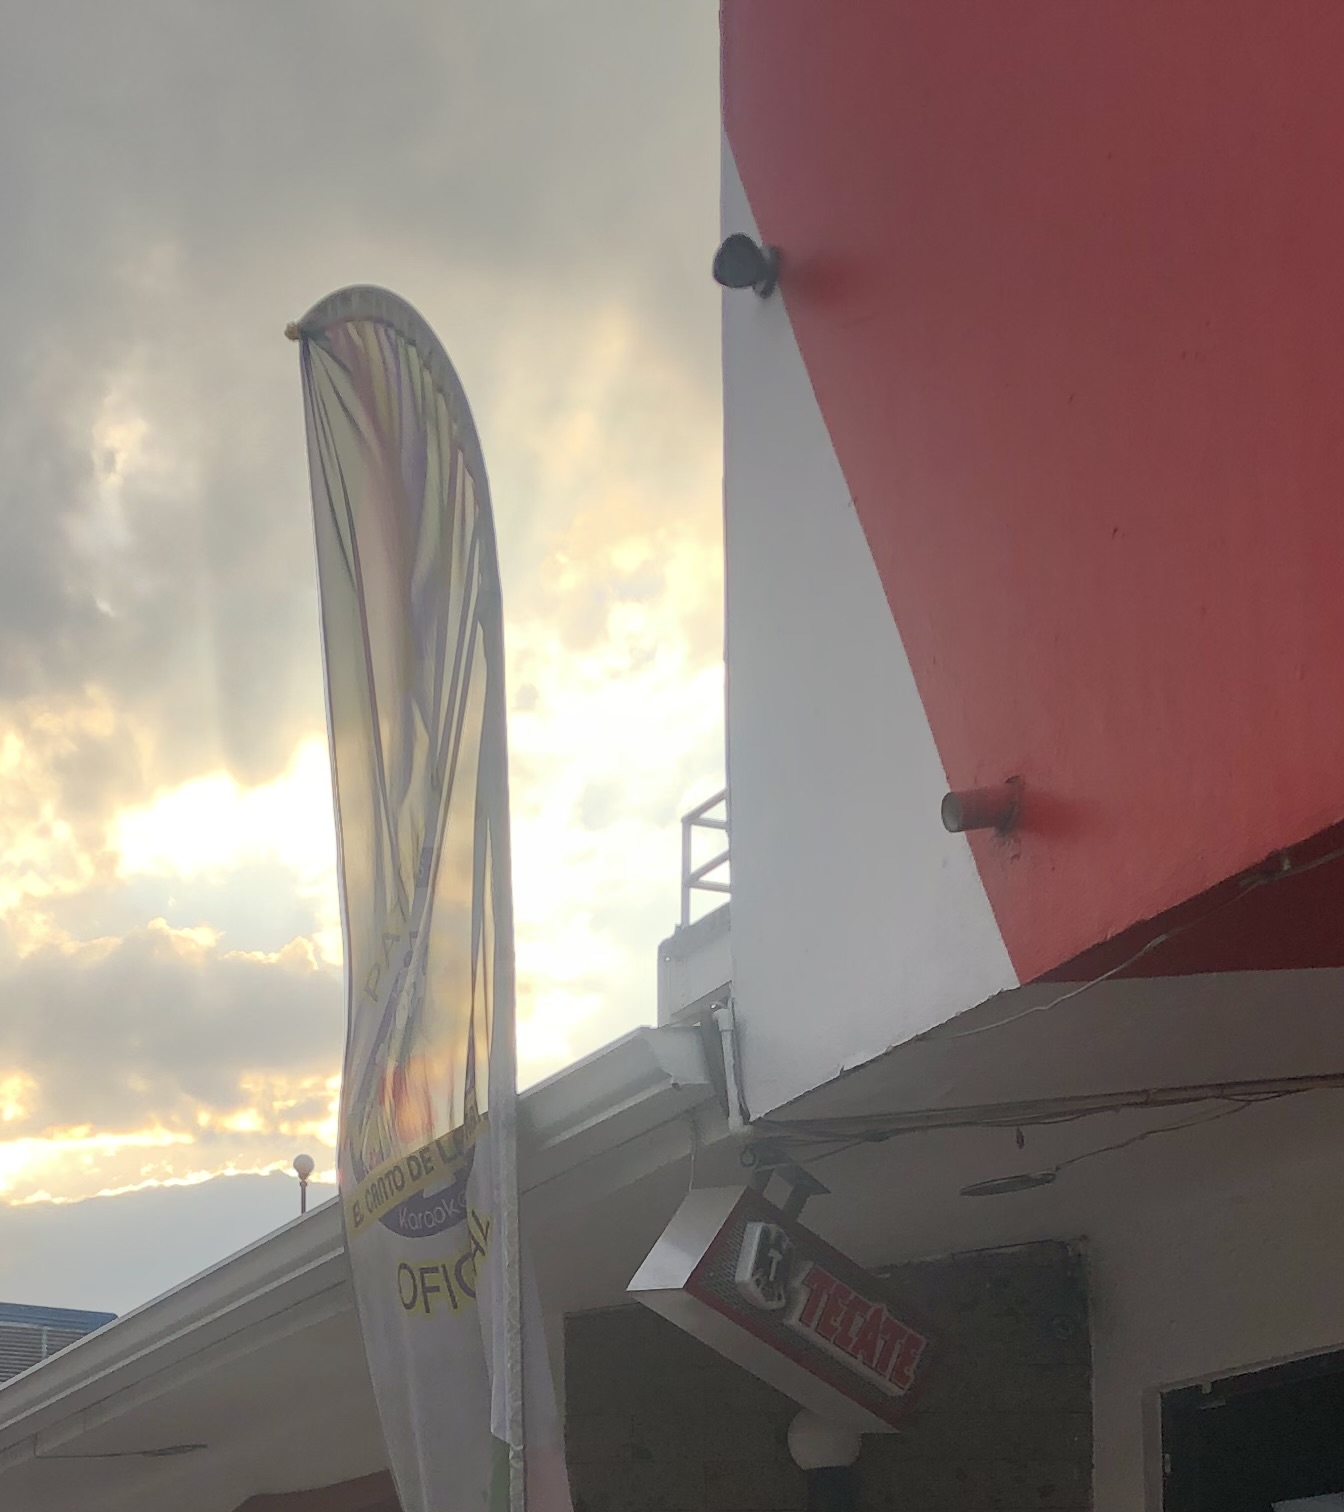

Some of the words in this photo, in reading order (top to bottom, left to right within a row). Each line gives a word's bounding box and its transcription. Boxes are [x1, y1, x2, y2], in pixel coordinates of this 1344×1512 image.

[365, 1165, 406, 1214] CANTO
[406, 1146, 435, 1182] DE
[799, 1264, 927, 1393] TECATE
